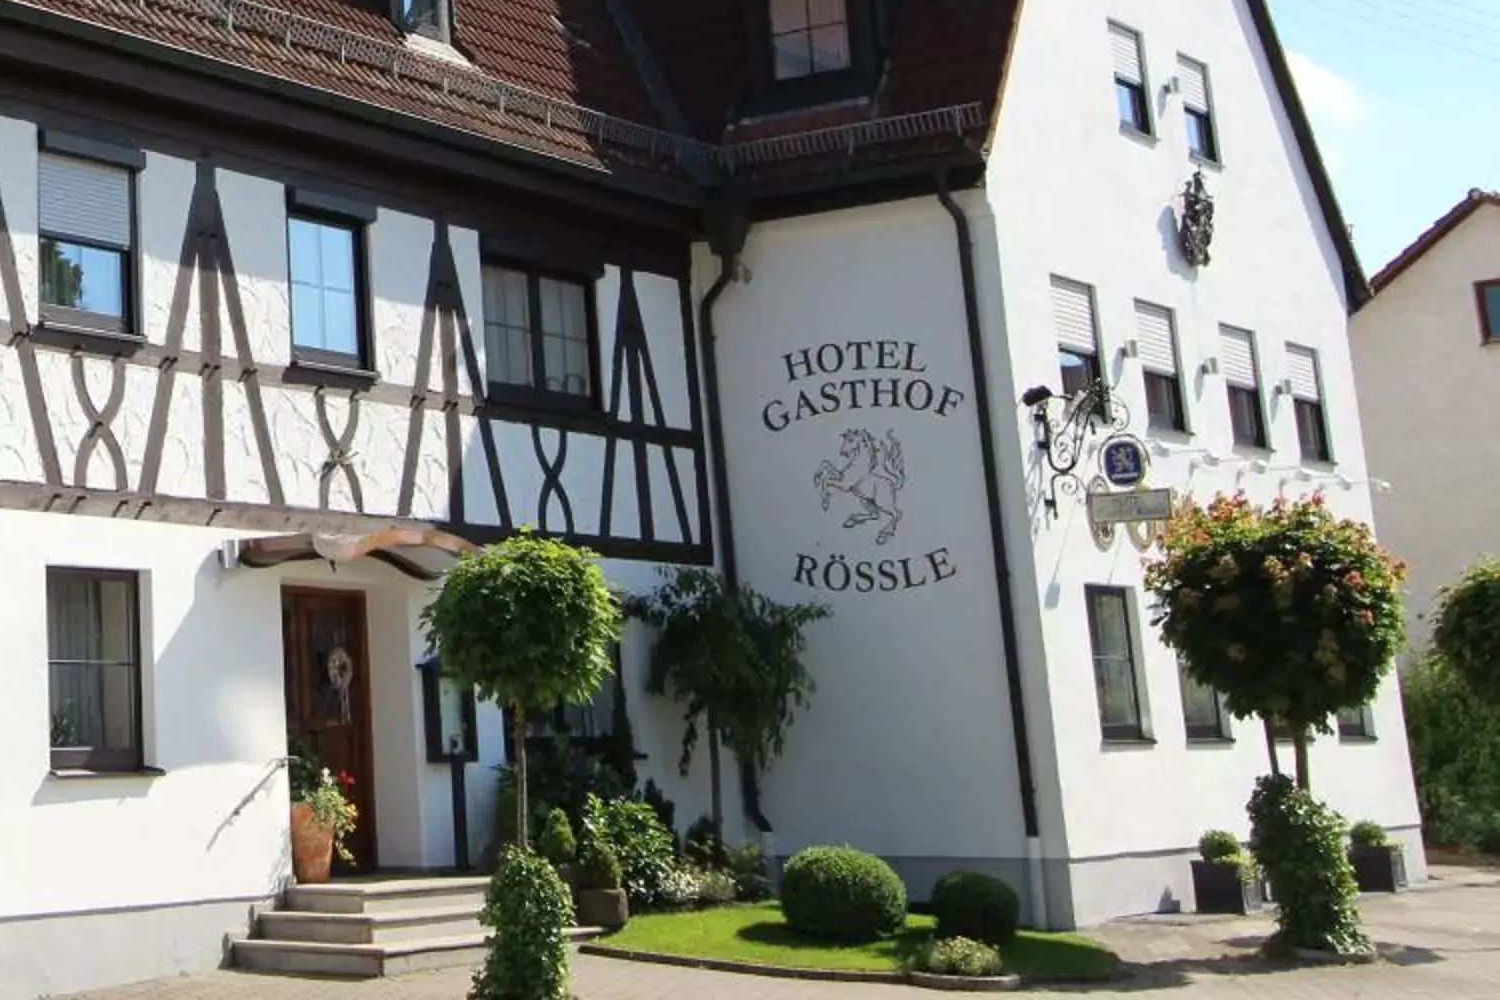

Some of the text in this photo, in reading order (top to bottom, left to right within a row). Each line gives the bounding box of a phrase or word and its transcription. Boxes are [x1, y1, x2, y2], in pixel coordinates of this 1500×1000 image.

[782, 340, 927, 382] HOTEL
[762, 379, 965, 431] GASTHOF
[793, 547, 957, 593] RÖSSLE
